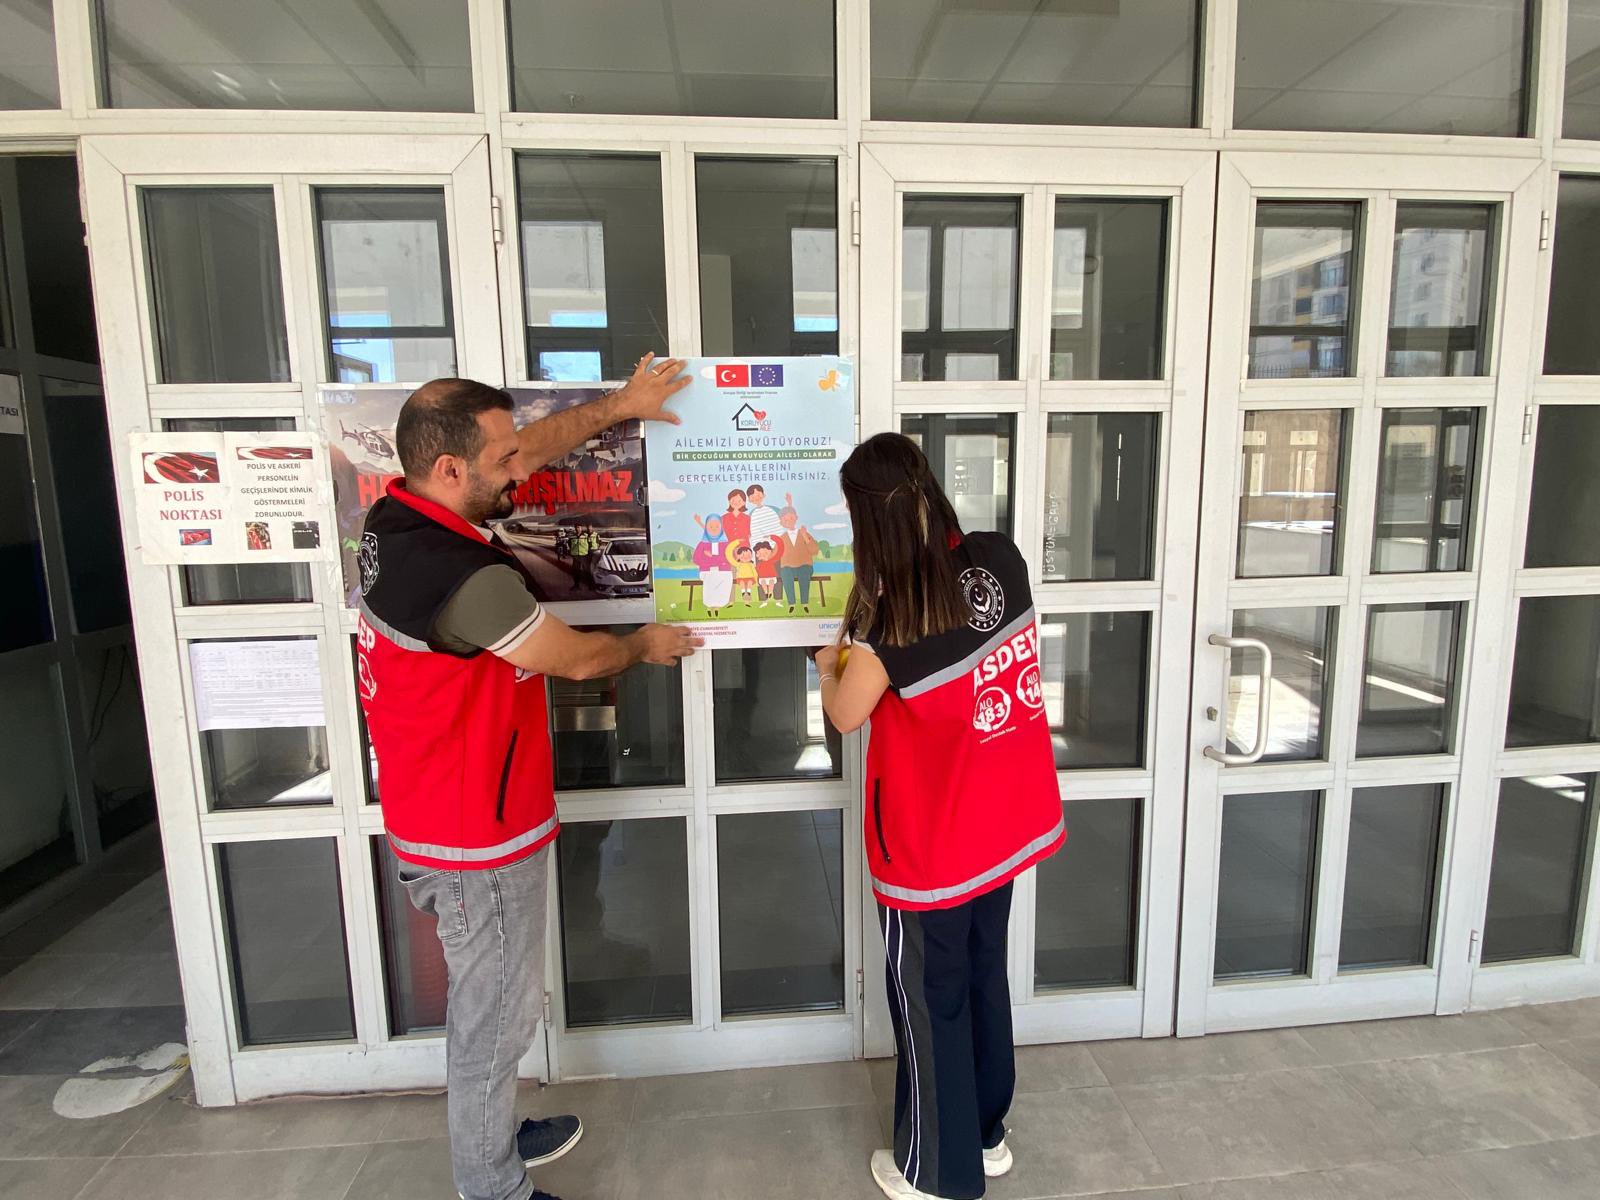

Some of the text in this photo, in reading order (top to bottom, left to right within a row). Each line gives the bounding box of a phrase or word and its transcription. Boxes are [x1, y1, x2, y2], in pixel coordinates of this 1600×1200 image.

[675, 436, 832, 448] AİLEMİZİ BÜYÜTÜYORUZ!
[692, 452, 730, 461] ÇOCUĞUN
[732, 452, 774, 460] KORUYUCU
[776, 451, 801, 459] AİLESİ
[277, 462, 301, 470] ASKERİ
[718, 462, 792, 473] HAYALLERİNİ
[257, 474, 299, 482] PERSONELİN
[678, 472, 831, 484] GERÇEKLEŞTİREBİLİRSİNİZ.
[164, 488, 205, 502] POLİS
[240, 486, 313, 495] GEÇİŞLERİNDE KİMLİK
[253, 498, 306, 506] GÖSTERMELERİ
[159, 509, 223, 521] NOKTASI
[1026, 671, 1039, 687] ALO
[979, 697, 993, 713] ALO
[976, 702, 1006, 725] 183
